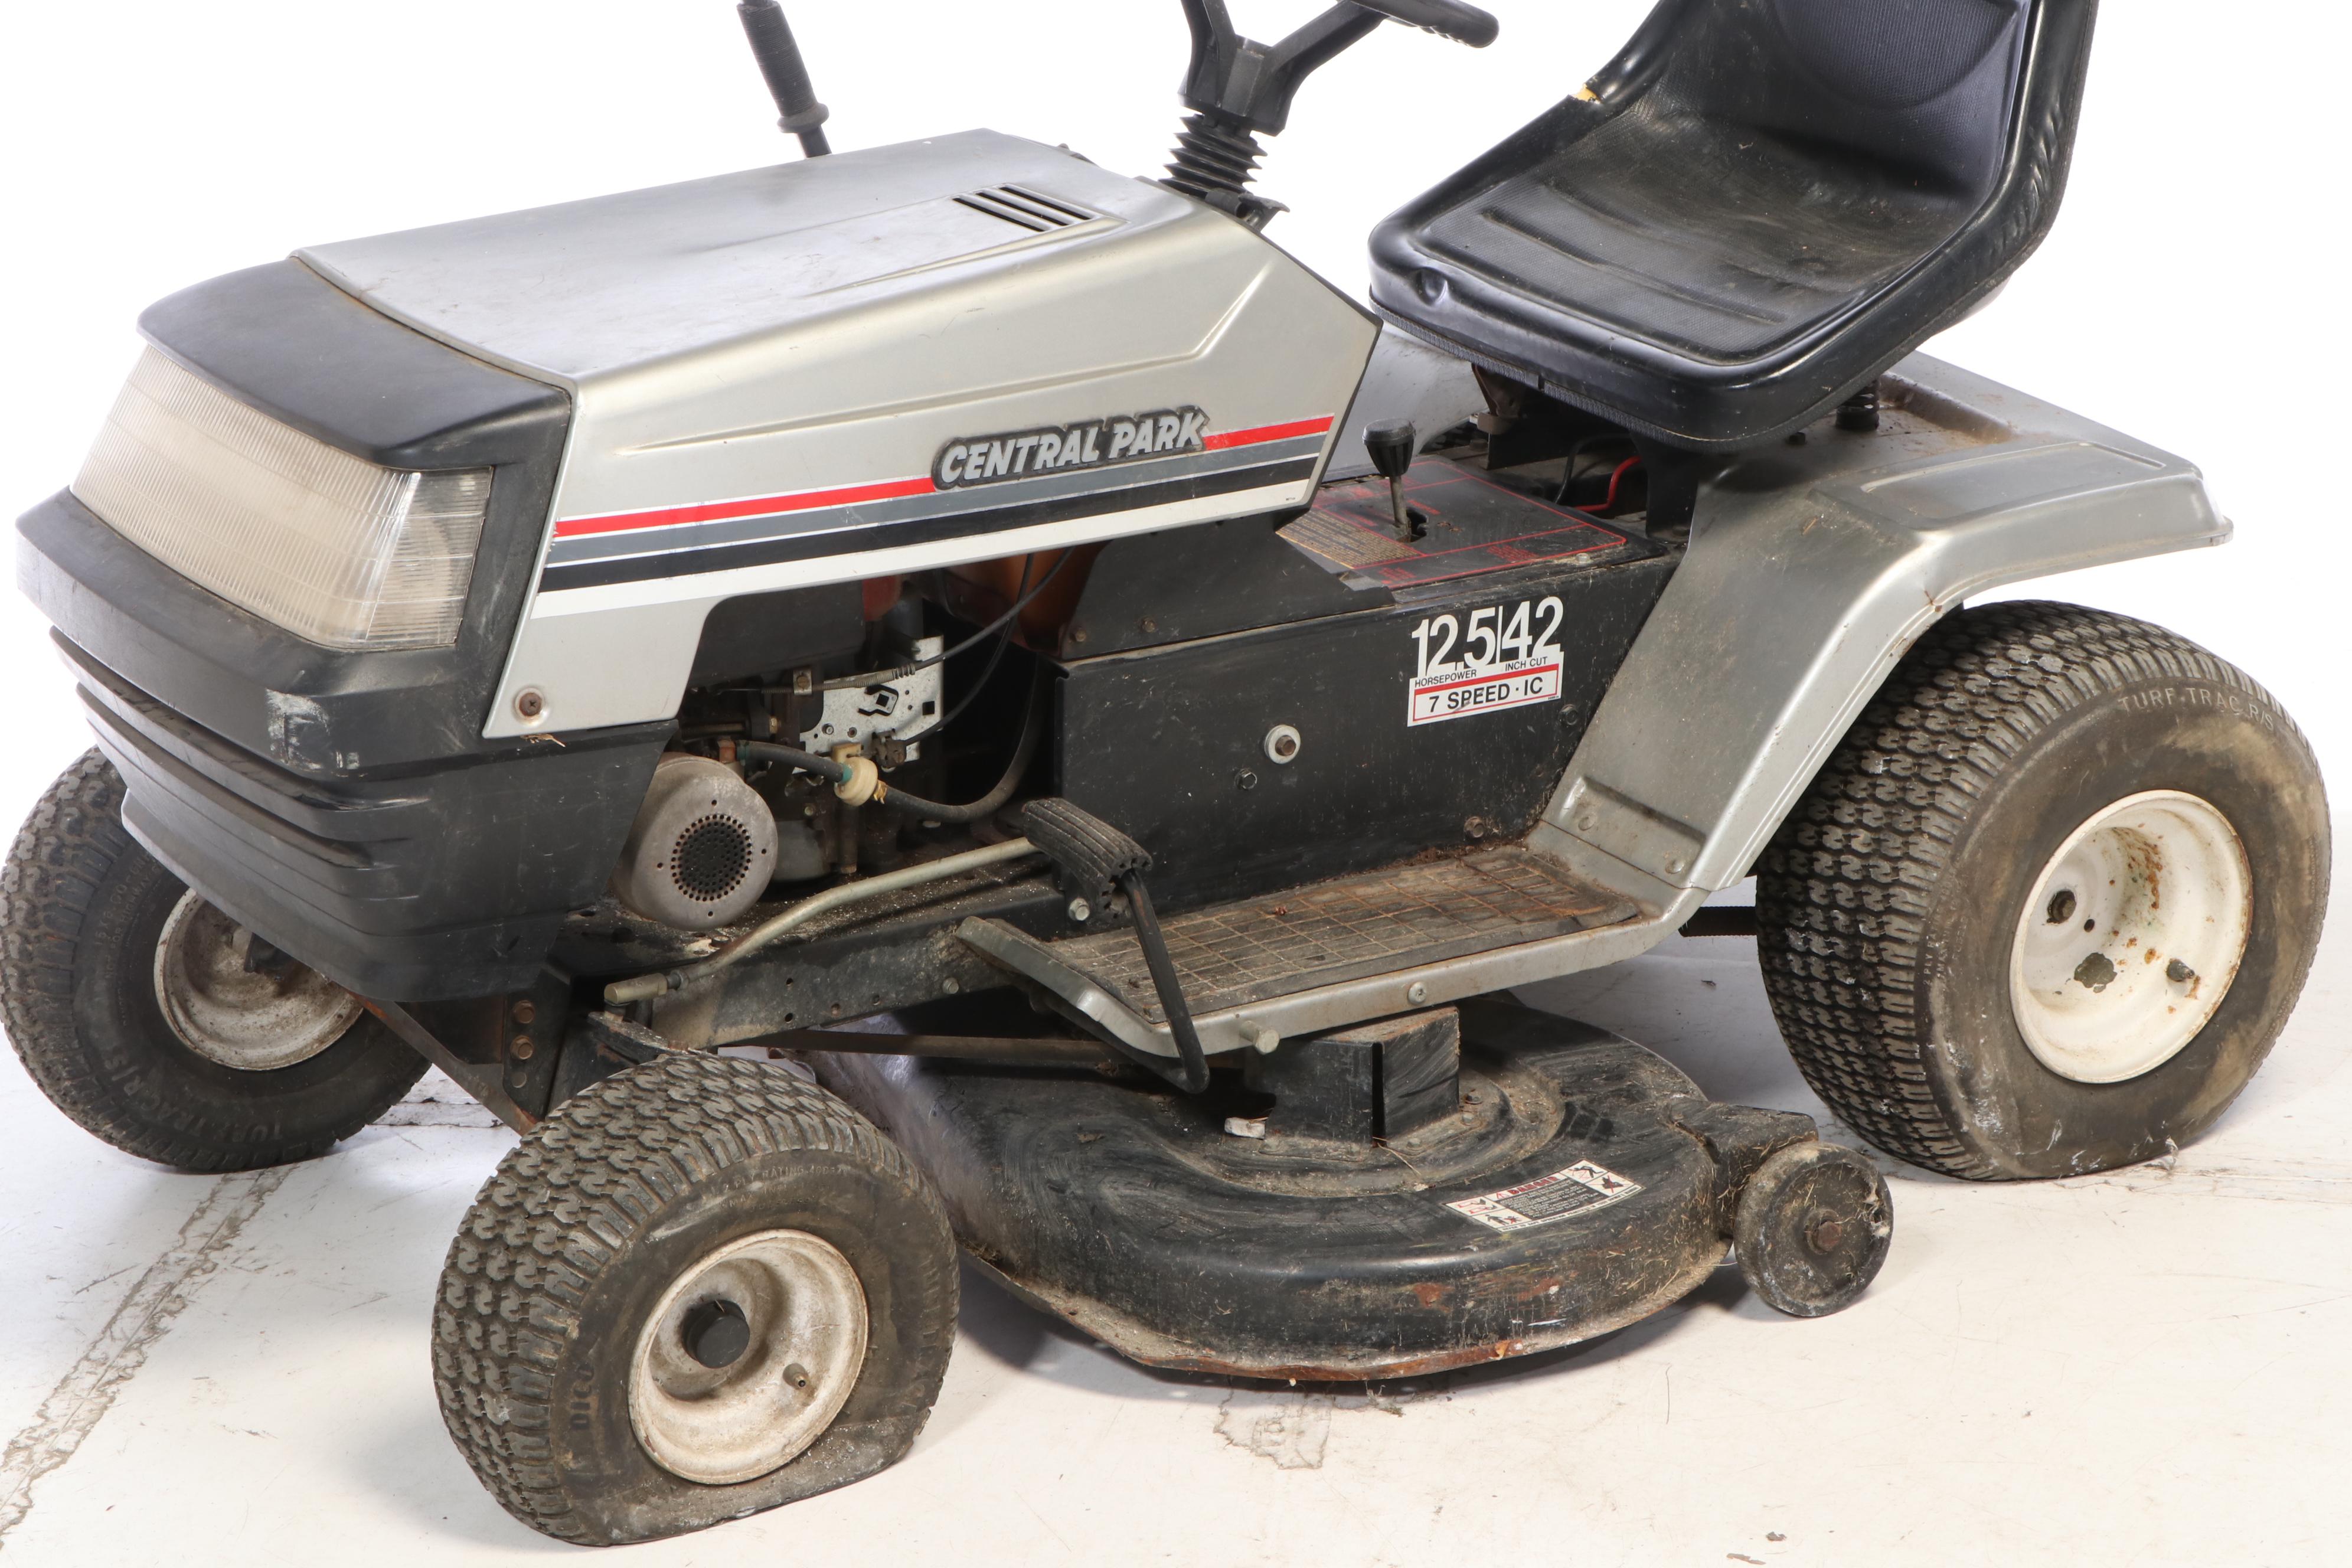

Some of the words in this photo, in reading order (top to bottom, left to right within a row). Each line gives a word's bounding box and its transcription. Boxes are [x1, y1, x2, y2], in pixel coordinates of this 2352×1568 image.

[940, 430, 1100, 484] CENTRAL
[1108, 411, 1207, 459] PARK
[1415, 669, 1477, 688] HORSEPOWER
[1505, 658, 1527, 671] INCH
[1529, 656, 1548, 667] CUT
[1429, 695, 1440, 713] 7
[1447, 683, 1510, 710] SPEED
[1523, 676, 1543, 696] IC
[2118, 687, 2175, 714] TURF
[2186, 687, 2240, 716] TRAC
[1507, 1175, 1560, 1195] DANGER
